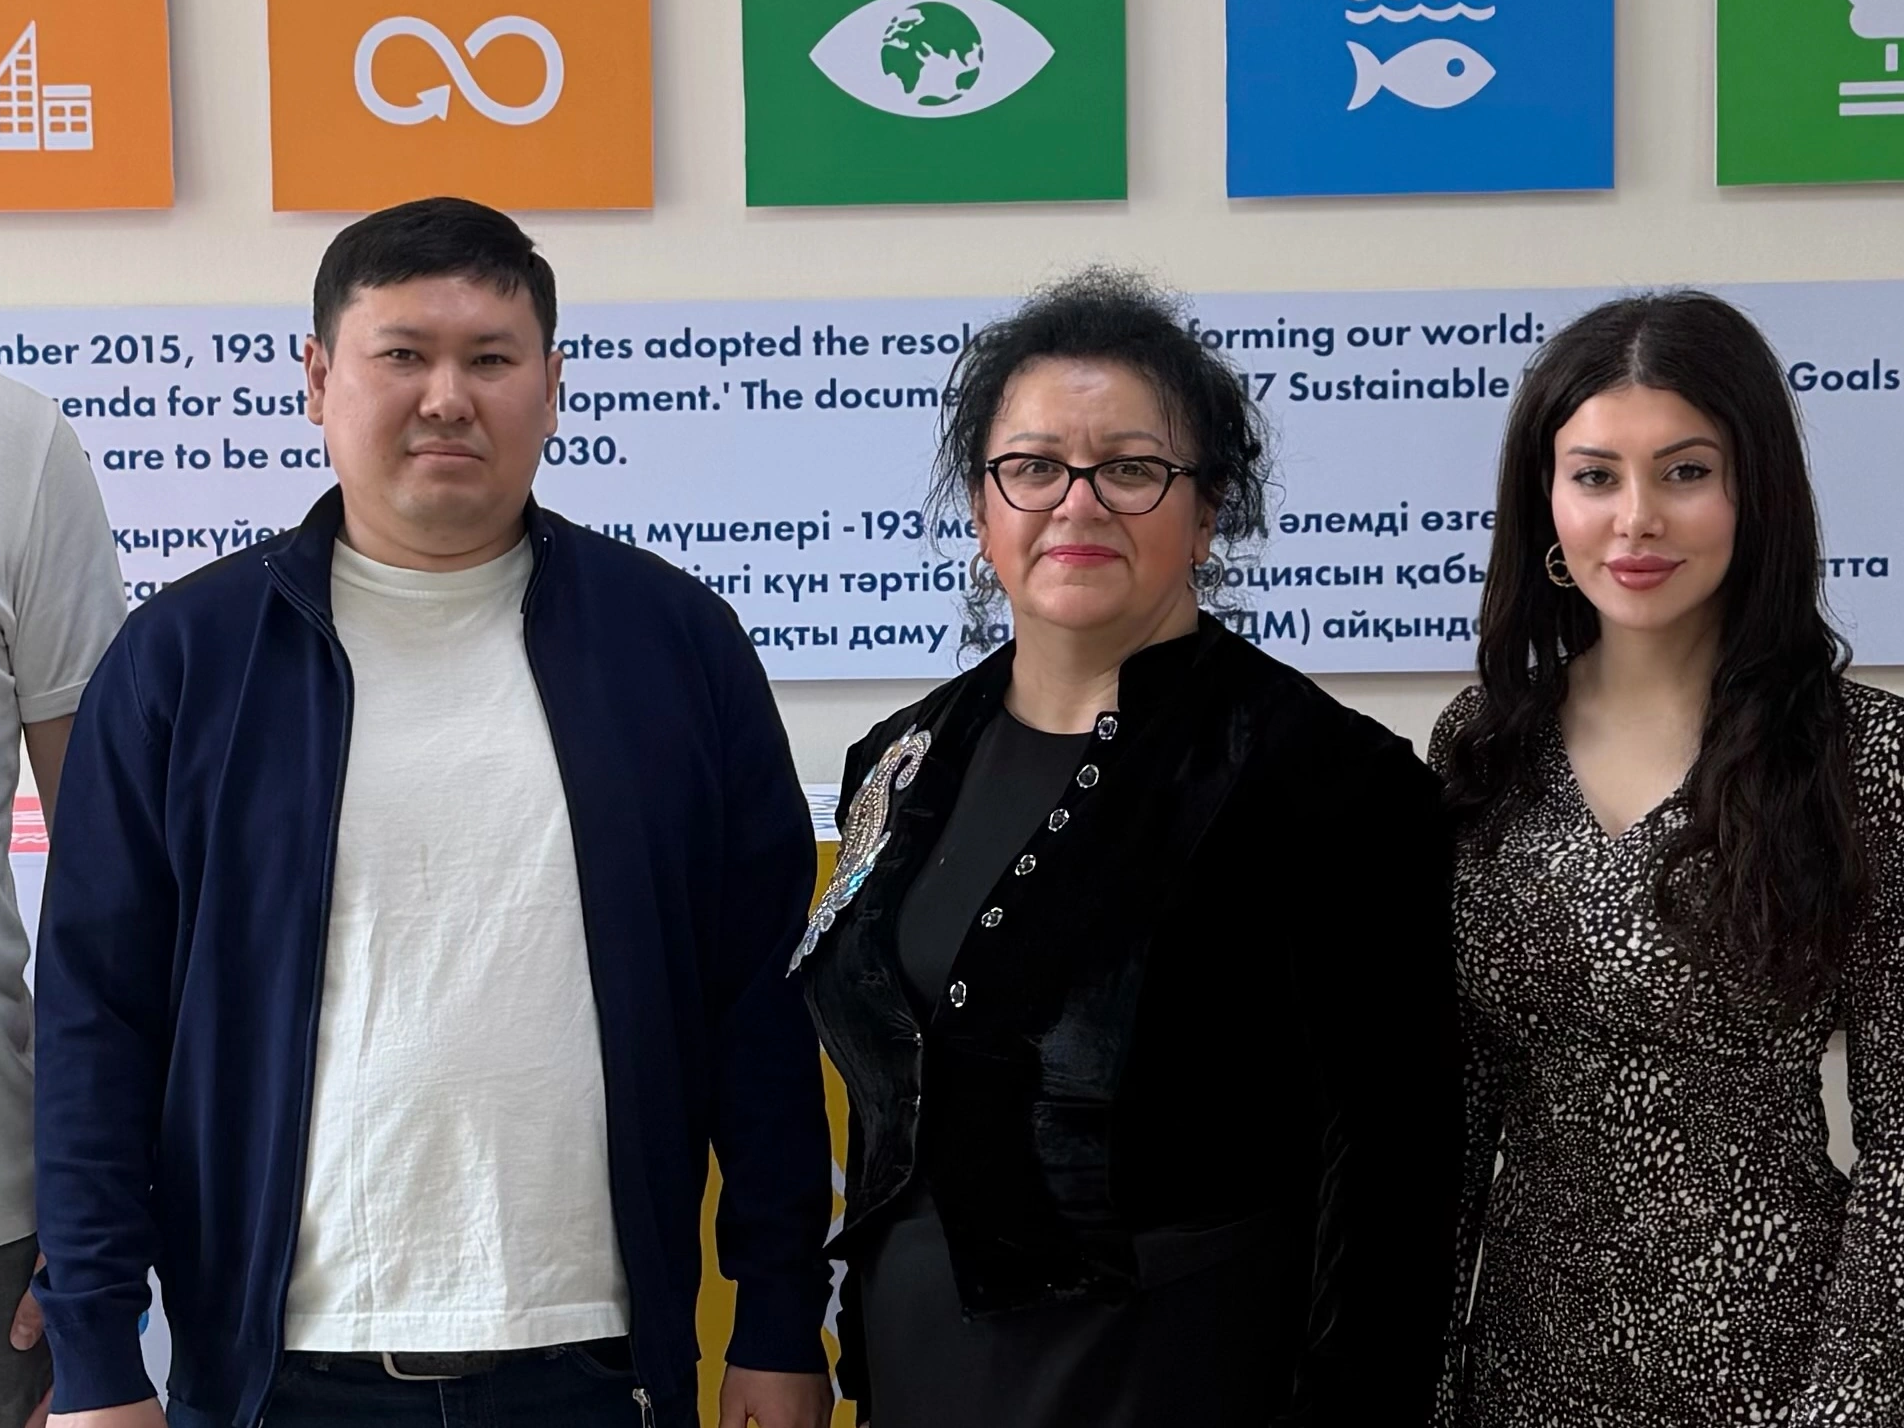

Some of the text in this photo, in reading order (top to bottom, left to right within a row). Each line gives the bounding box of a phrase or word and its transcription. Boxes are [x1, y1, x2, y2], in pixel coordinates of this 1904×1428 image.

[90, 335, 194, 368] 2015,
[213, 334, 275, 363] 193
[559, 333, 632, 360] ates
[645, 328, 800, 365] adopted
[813, 326, 869, 357] the
[881, 323, 970, 355] resol
[1347, 324, 1410, 347] our
[1422, 313, 1544, 344] world:
[61, 387, 155, 418] enda
[168, 386, 221, 416] for
[559, 383, 730, 420] lopment.'
[742, 378, 803, 410] The
[815, 378, 960, 409] docume
[1289, 369, 1509, 401] Sustainable
[1788, 358, 1899, 392] Goals
[104, 449, 164, 469] are
[175, 443, 211, 469] to
[223, 439, 268, 468] be
[543, 436, 627, 465] 030.
[646, 510, 830, 551] мүшелері
[1279, 502, 1407, 536] әлемді
[764, 572, 828, 601] күн
[754, 624, 838, 649] ақты
[849, 623, 948, 652] даму
